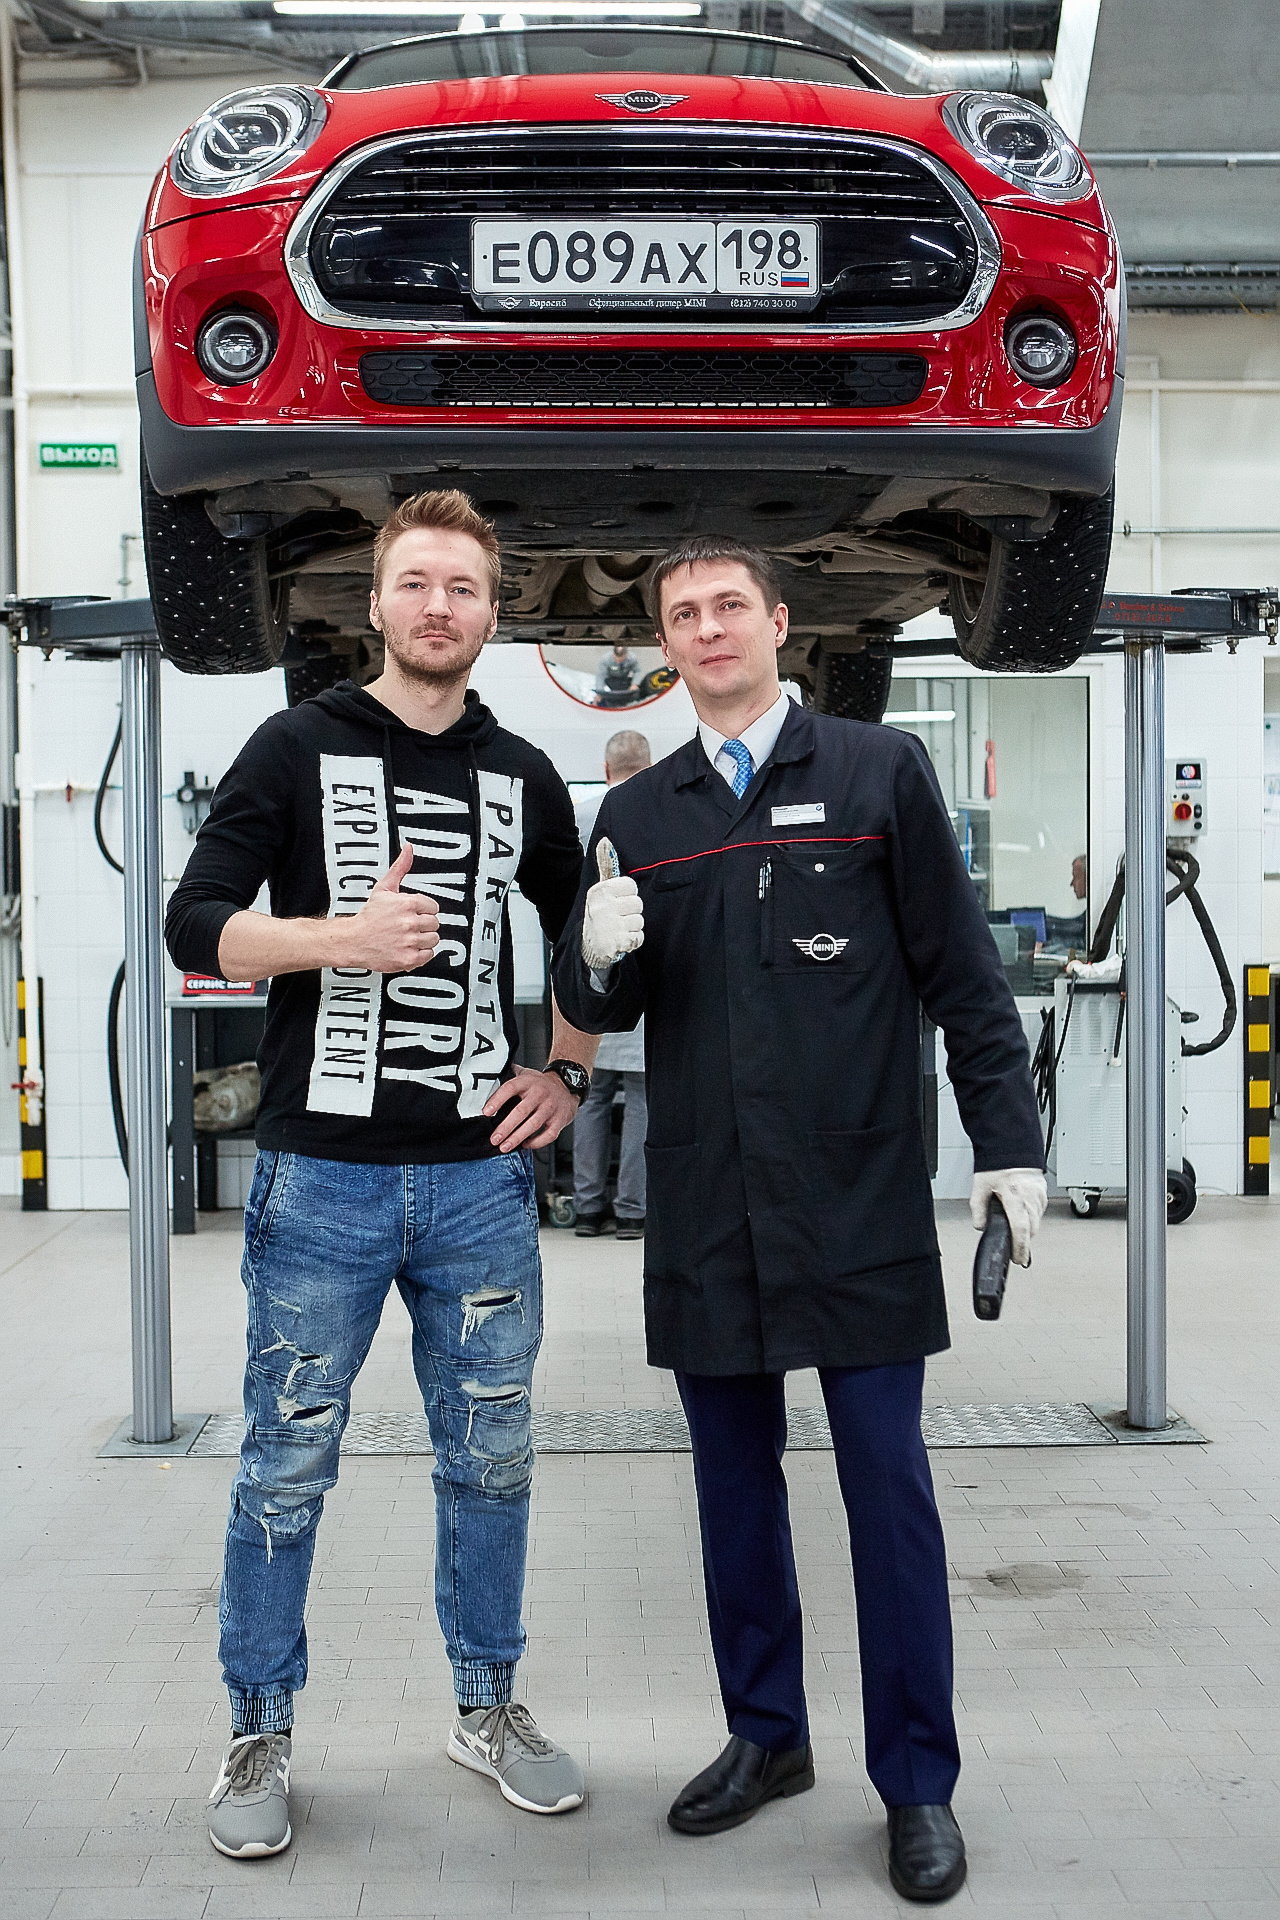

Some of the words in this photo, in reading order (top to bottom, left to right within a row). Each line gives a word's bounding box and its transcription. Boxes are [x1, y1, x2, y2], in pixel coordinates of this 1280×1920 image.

[721, 229, 802, 270] 198
[739, 271, 779, 287] RUS
[683, 298, 707, 308] MINI
[752, 299, 770, 308] 740
[42, 446, 116, 466] ВЫХОД
[332, 783, 380, 918] EXPLICI
[470, 800, 515, 1090] PARENTAL
[813, 943, 834, 951] MINI
